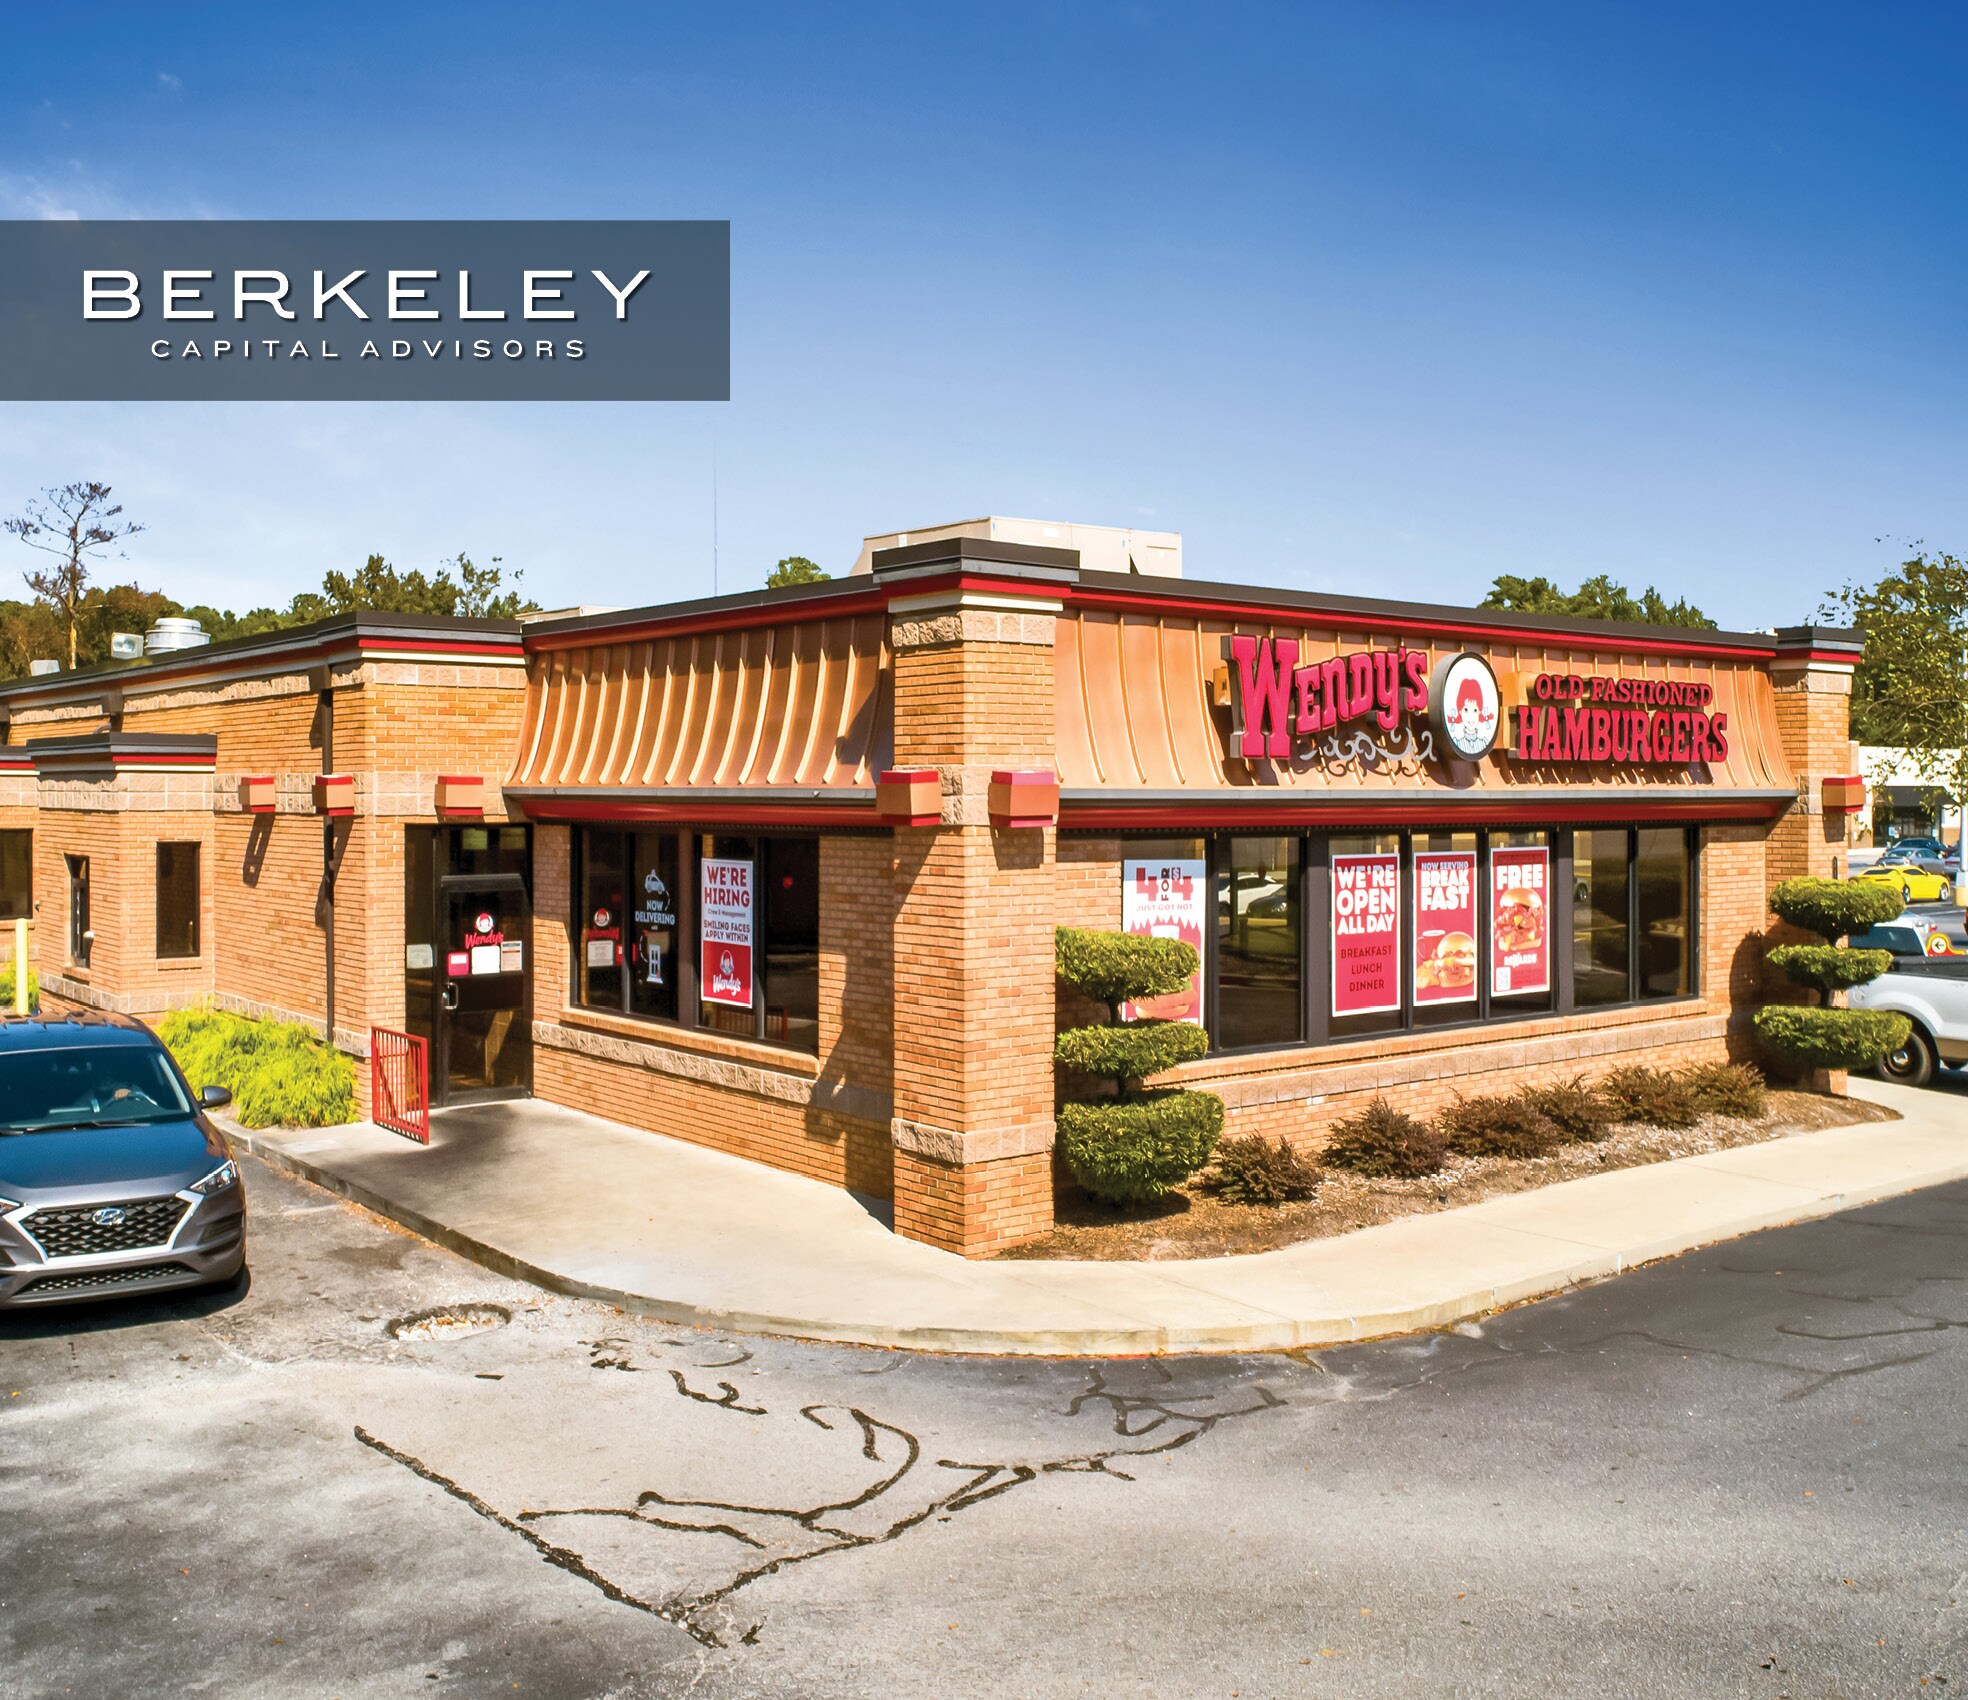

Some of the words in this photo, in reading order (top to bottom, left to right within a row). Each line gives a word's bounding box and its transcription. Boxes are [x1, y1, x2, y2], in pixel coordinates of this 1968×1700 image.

[1535, 674, 1584, 700] OLD
[1591, 677, 1713, 707] FASHIONED
[1518, 706, 1728, 762] HAMBURGERS
[1421, 862, 1439, 870] NOW
[1440, 861, 1469, 870] SERVING
[707, 865, 747, 887] WE'RE
[1136, 867, 1159, 902] 4
[1161, 867, 1170, 902] FOR
[1336, 864, 1396, 889] WE'RE
[1421, 869, 1470, 887] BREAK
[1496, 863, 1543, 890] FREE
[646, 900, 664, 911] NOW
[704, 887, 750, 908] HIRING
[1336, 887, 1396, 916] OPEN
[1421, 886, 1470, 911] FAST
[1137, 904, 1156, 912] JUST
[1157, 903, 1175, 911] GOT
[1177, 903, 1193, 911] HOT
[635, 911, 676, 925] DELIVERING
[703, 919, 730, 931] SMILING
[731, 922, 751, 933] FACES
[1337, 916, 1365, 935] ALL
[1366, 914, 1395, 933] DAY
[705, 930, 724, 940] APPLY
[726, 932, 749, 942] WITHIN
[1340, 945, 1393, 959] BREAKFAST
[1351, 963, 1382, 975] LUNCH
[1349, 979, 1385, 992] DINNER
